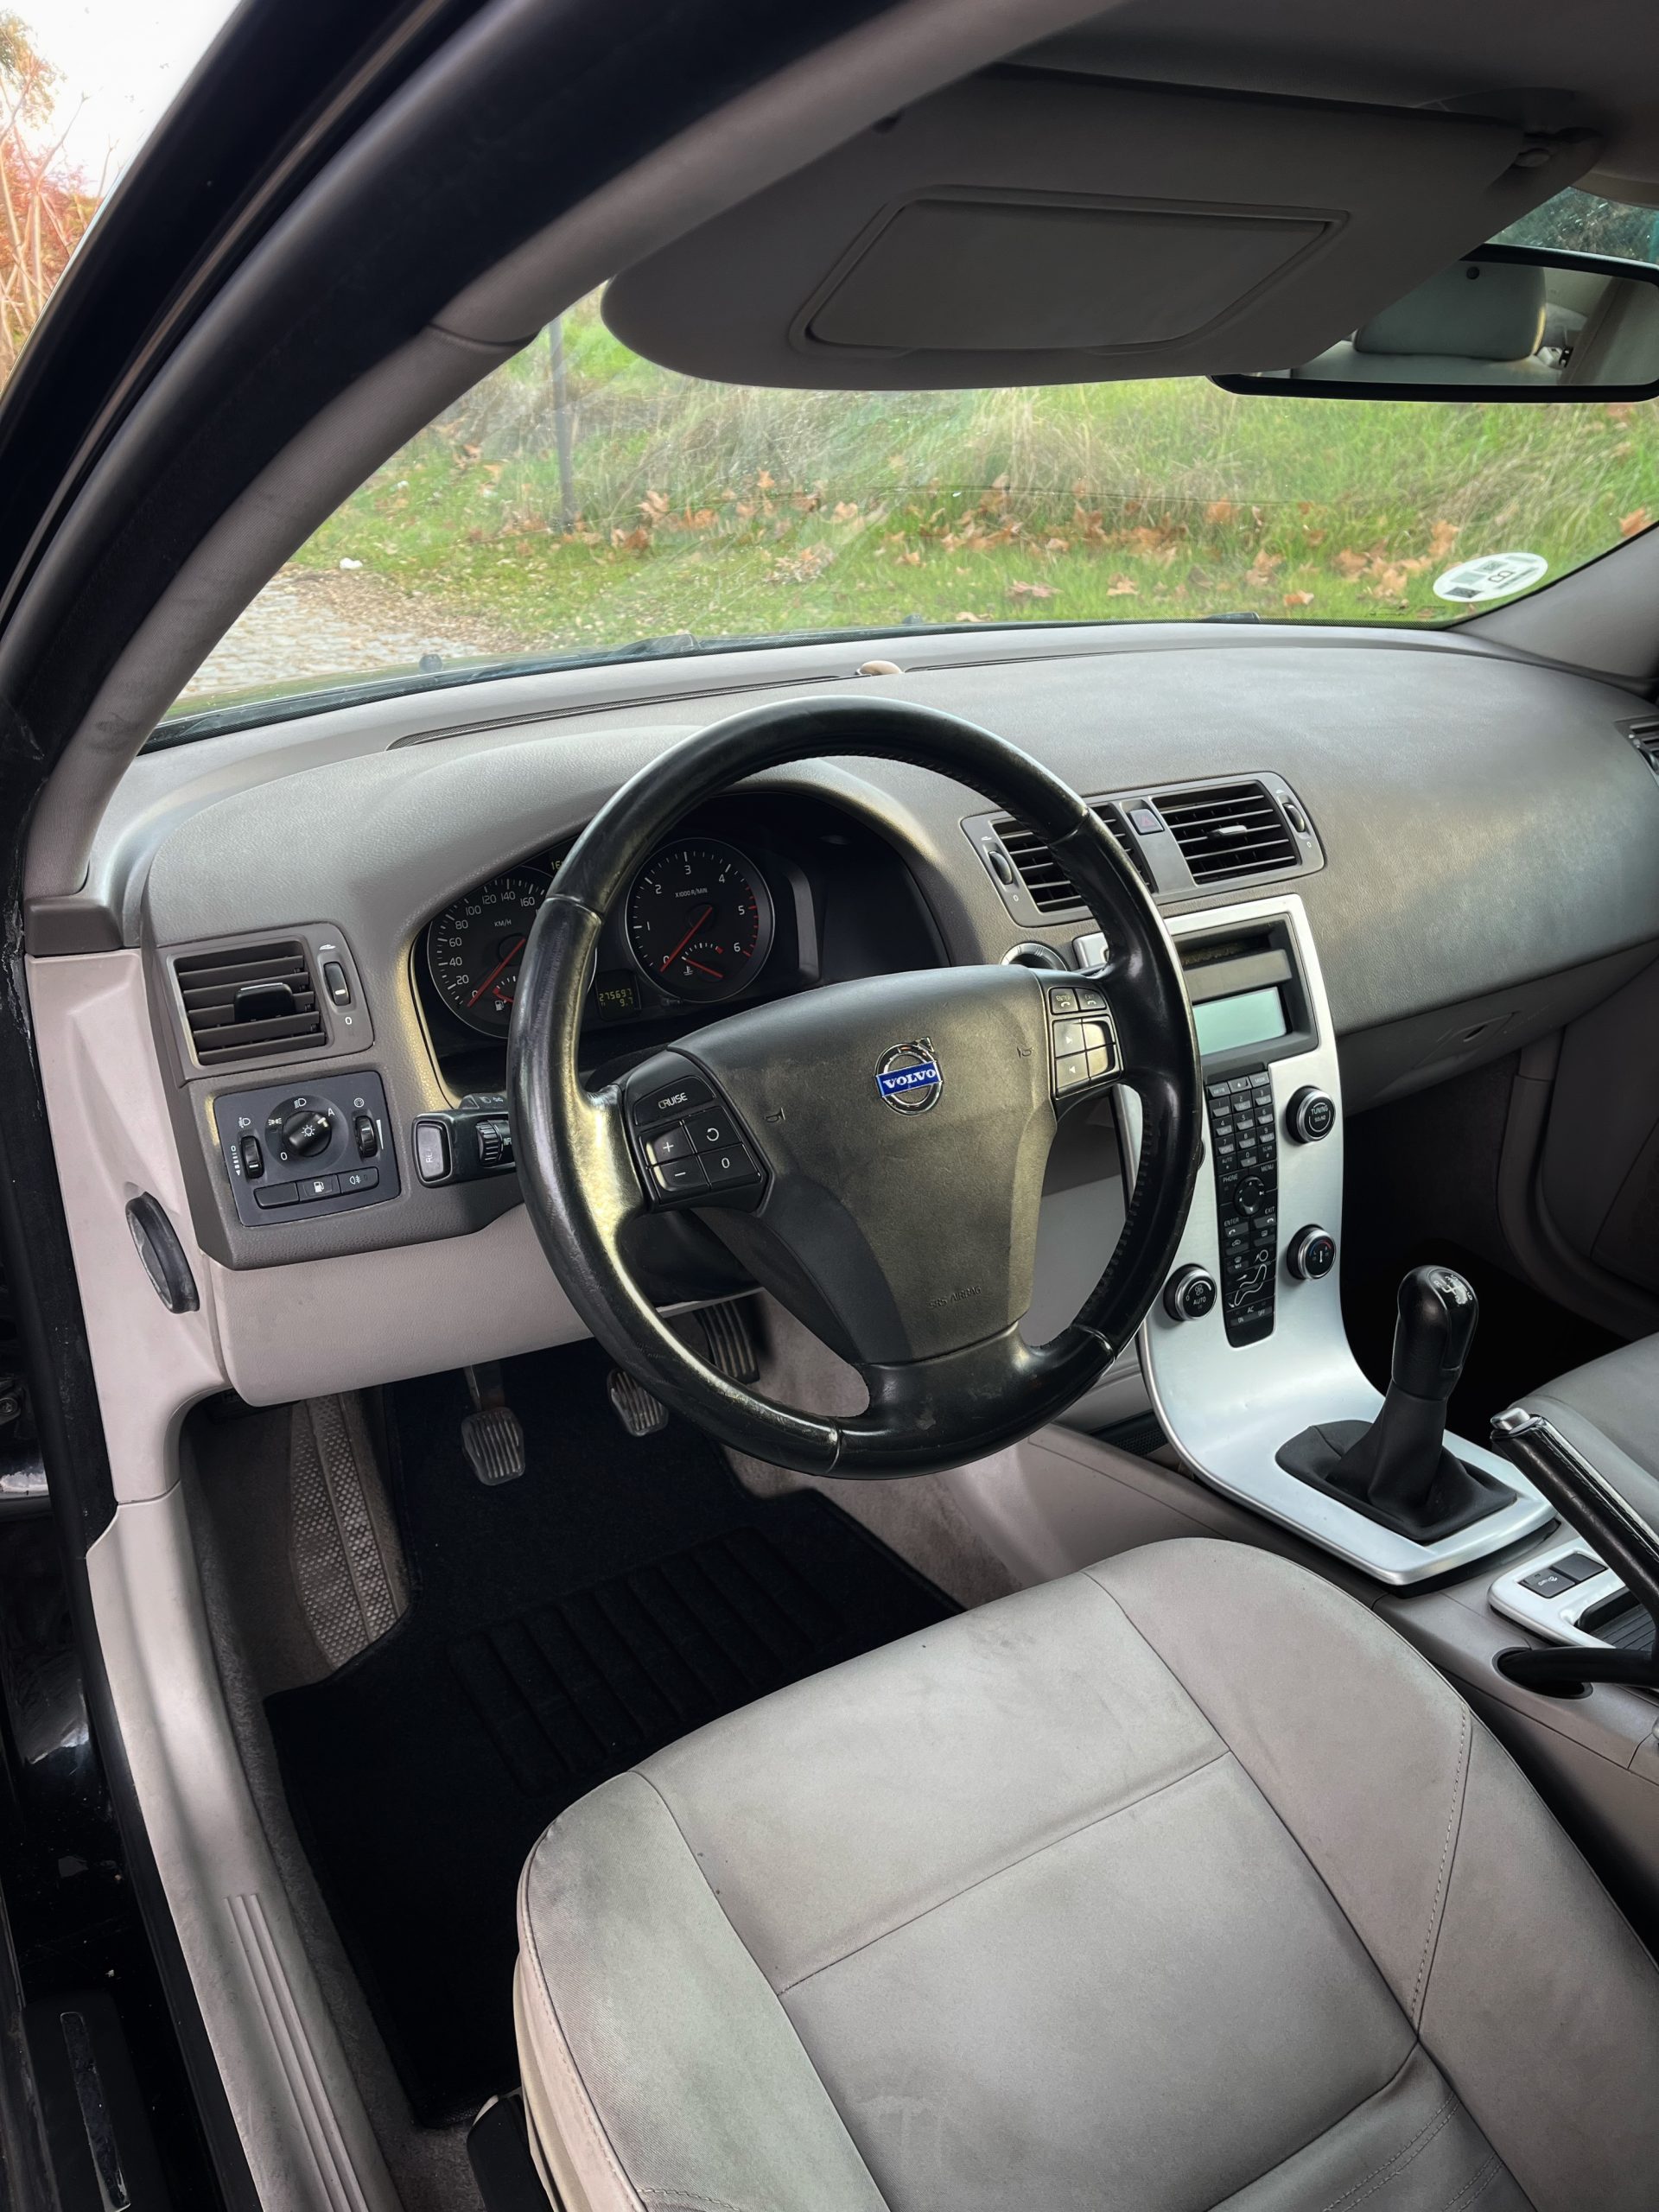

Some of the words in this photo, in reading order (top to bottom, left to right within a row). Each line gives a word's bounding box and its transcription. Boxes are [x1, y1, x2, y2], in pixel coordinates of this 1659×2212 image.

[684, 865, 691, 875] 3
[718, 874, 726, 884] 4
[655, 885, 663, 894] 2
[482, 895, 497, 905] 120
[501, 892, 516, 901] 140
[520, 897, 535, 906] 160
[466, 905, 481, 916] 100
[738, 906, 745, 915] 5
[455, 919, 468, 930] 80
[647, 921, 651, 931] 1
[448, 938, 462, 947] 60
[734, 943, 741, 952] 6
[449, 957, 462, 967] 40
[456, 975, 469, 984] 20
[883, 1069, 936, 1089] VOLVO
[658, 1092, 688, 1109] CRUISE
[327, 1108, 335, 1116] A
[1311, 1105, 1328, 1115] TUNING
[280, 1152, 288, 1160] 0
[721, 1157, 730, 1169] 0
[1262, 1163, 1274, 1172] MENU
[1223, 1173, 1238, 1183] PHONE
[1264, 1206, 1275, 1215] EXIT
[1224, 1217, 1239, 1226] ENTER
[1193, 1296, 1206, 1306] AUTO
